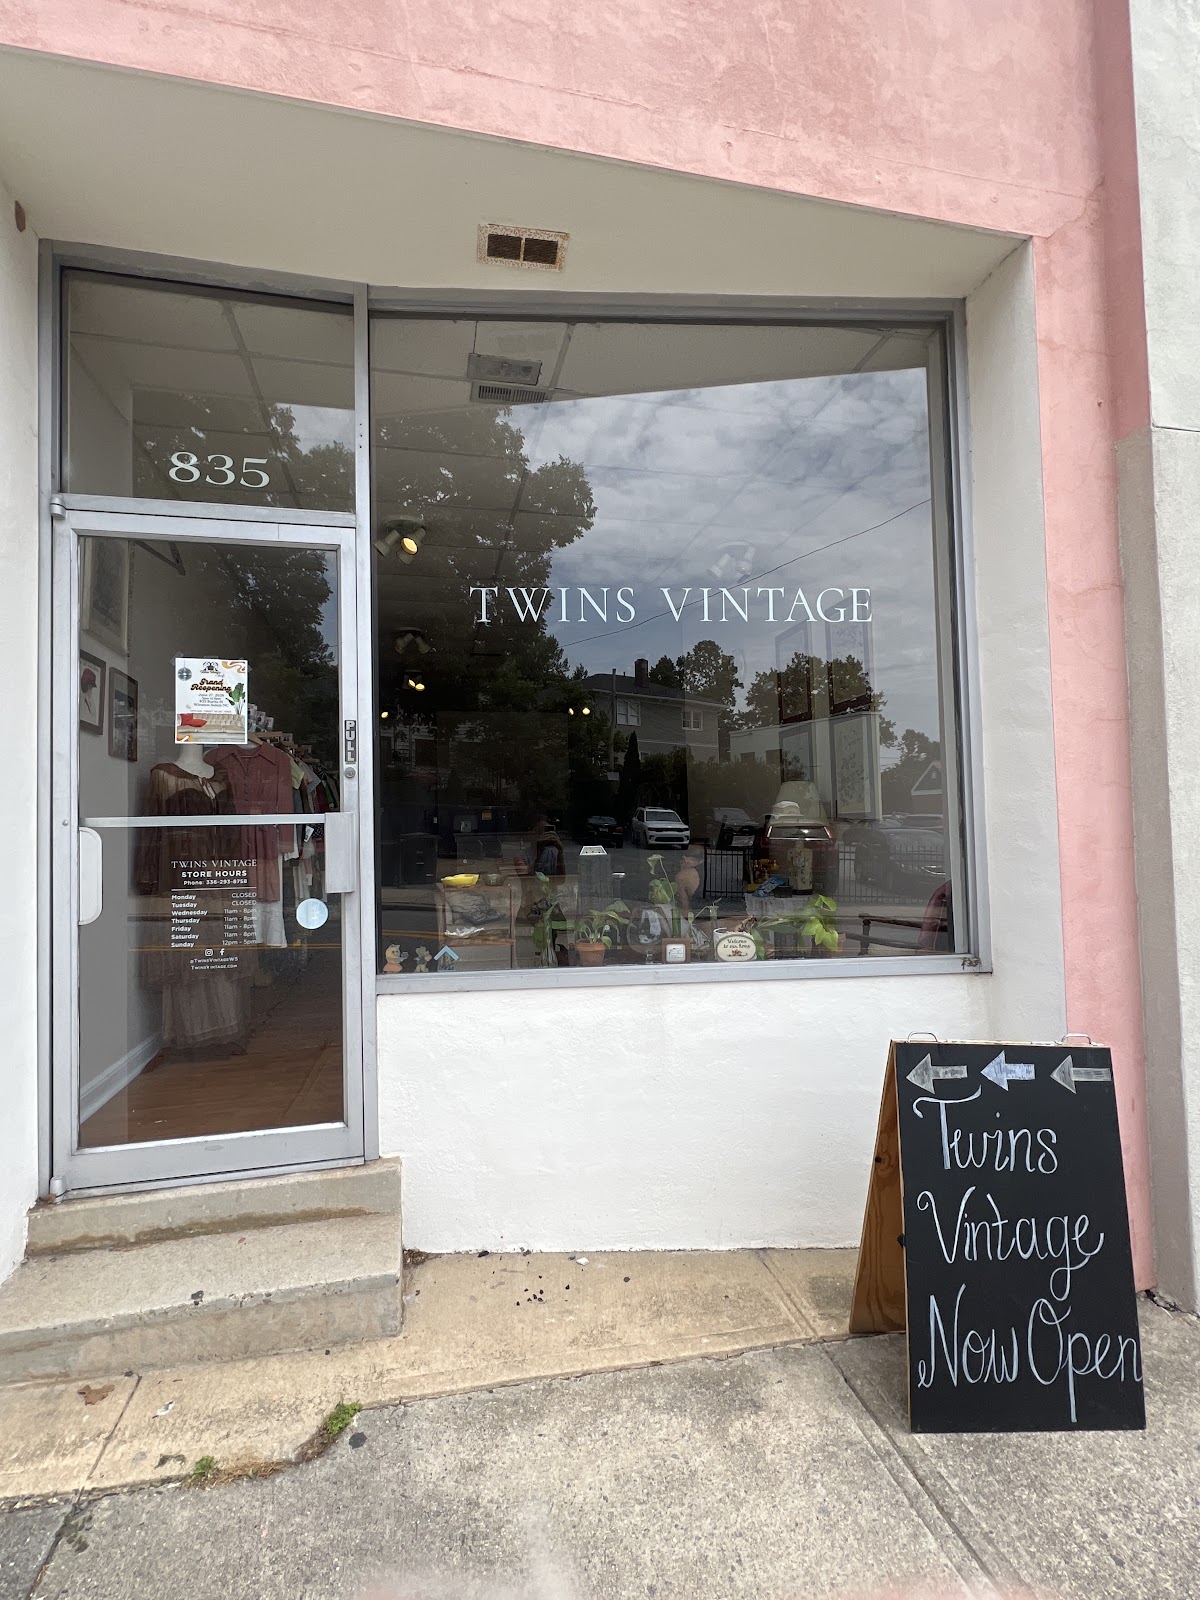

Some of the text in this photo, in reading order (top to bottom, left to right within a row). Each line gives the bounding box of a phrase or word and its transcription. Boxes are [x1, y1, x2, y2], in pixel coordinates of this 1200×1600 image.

[169, 451, 270, 488] 835
[470, 587, 873, 623] TWINS VINTAGE
[190, 684, 232, 693] Reopening
[200, 678, 224, 686] Grand
[345, 720, 356, 761] PULL
[171, 859, 257, 868] TWINS VINTAGE
[181, 870, 212, 878] STORE
[171, 909, 208, 917] Wednesday
[912, 1084, 1059, 1175] Twins
[916, 1186, 1105, 1301] Vintage
[917, 1283, 1144, 1423] Now Open
